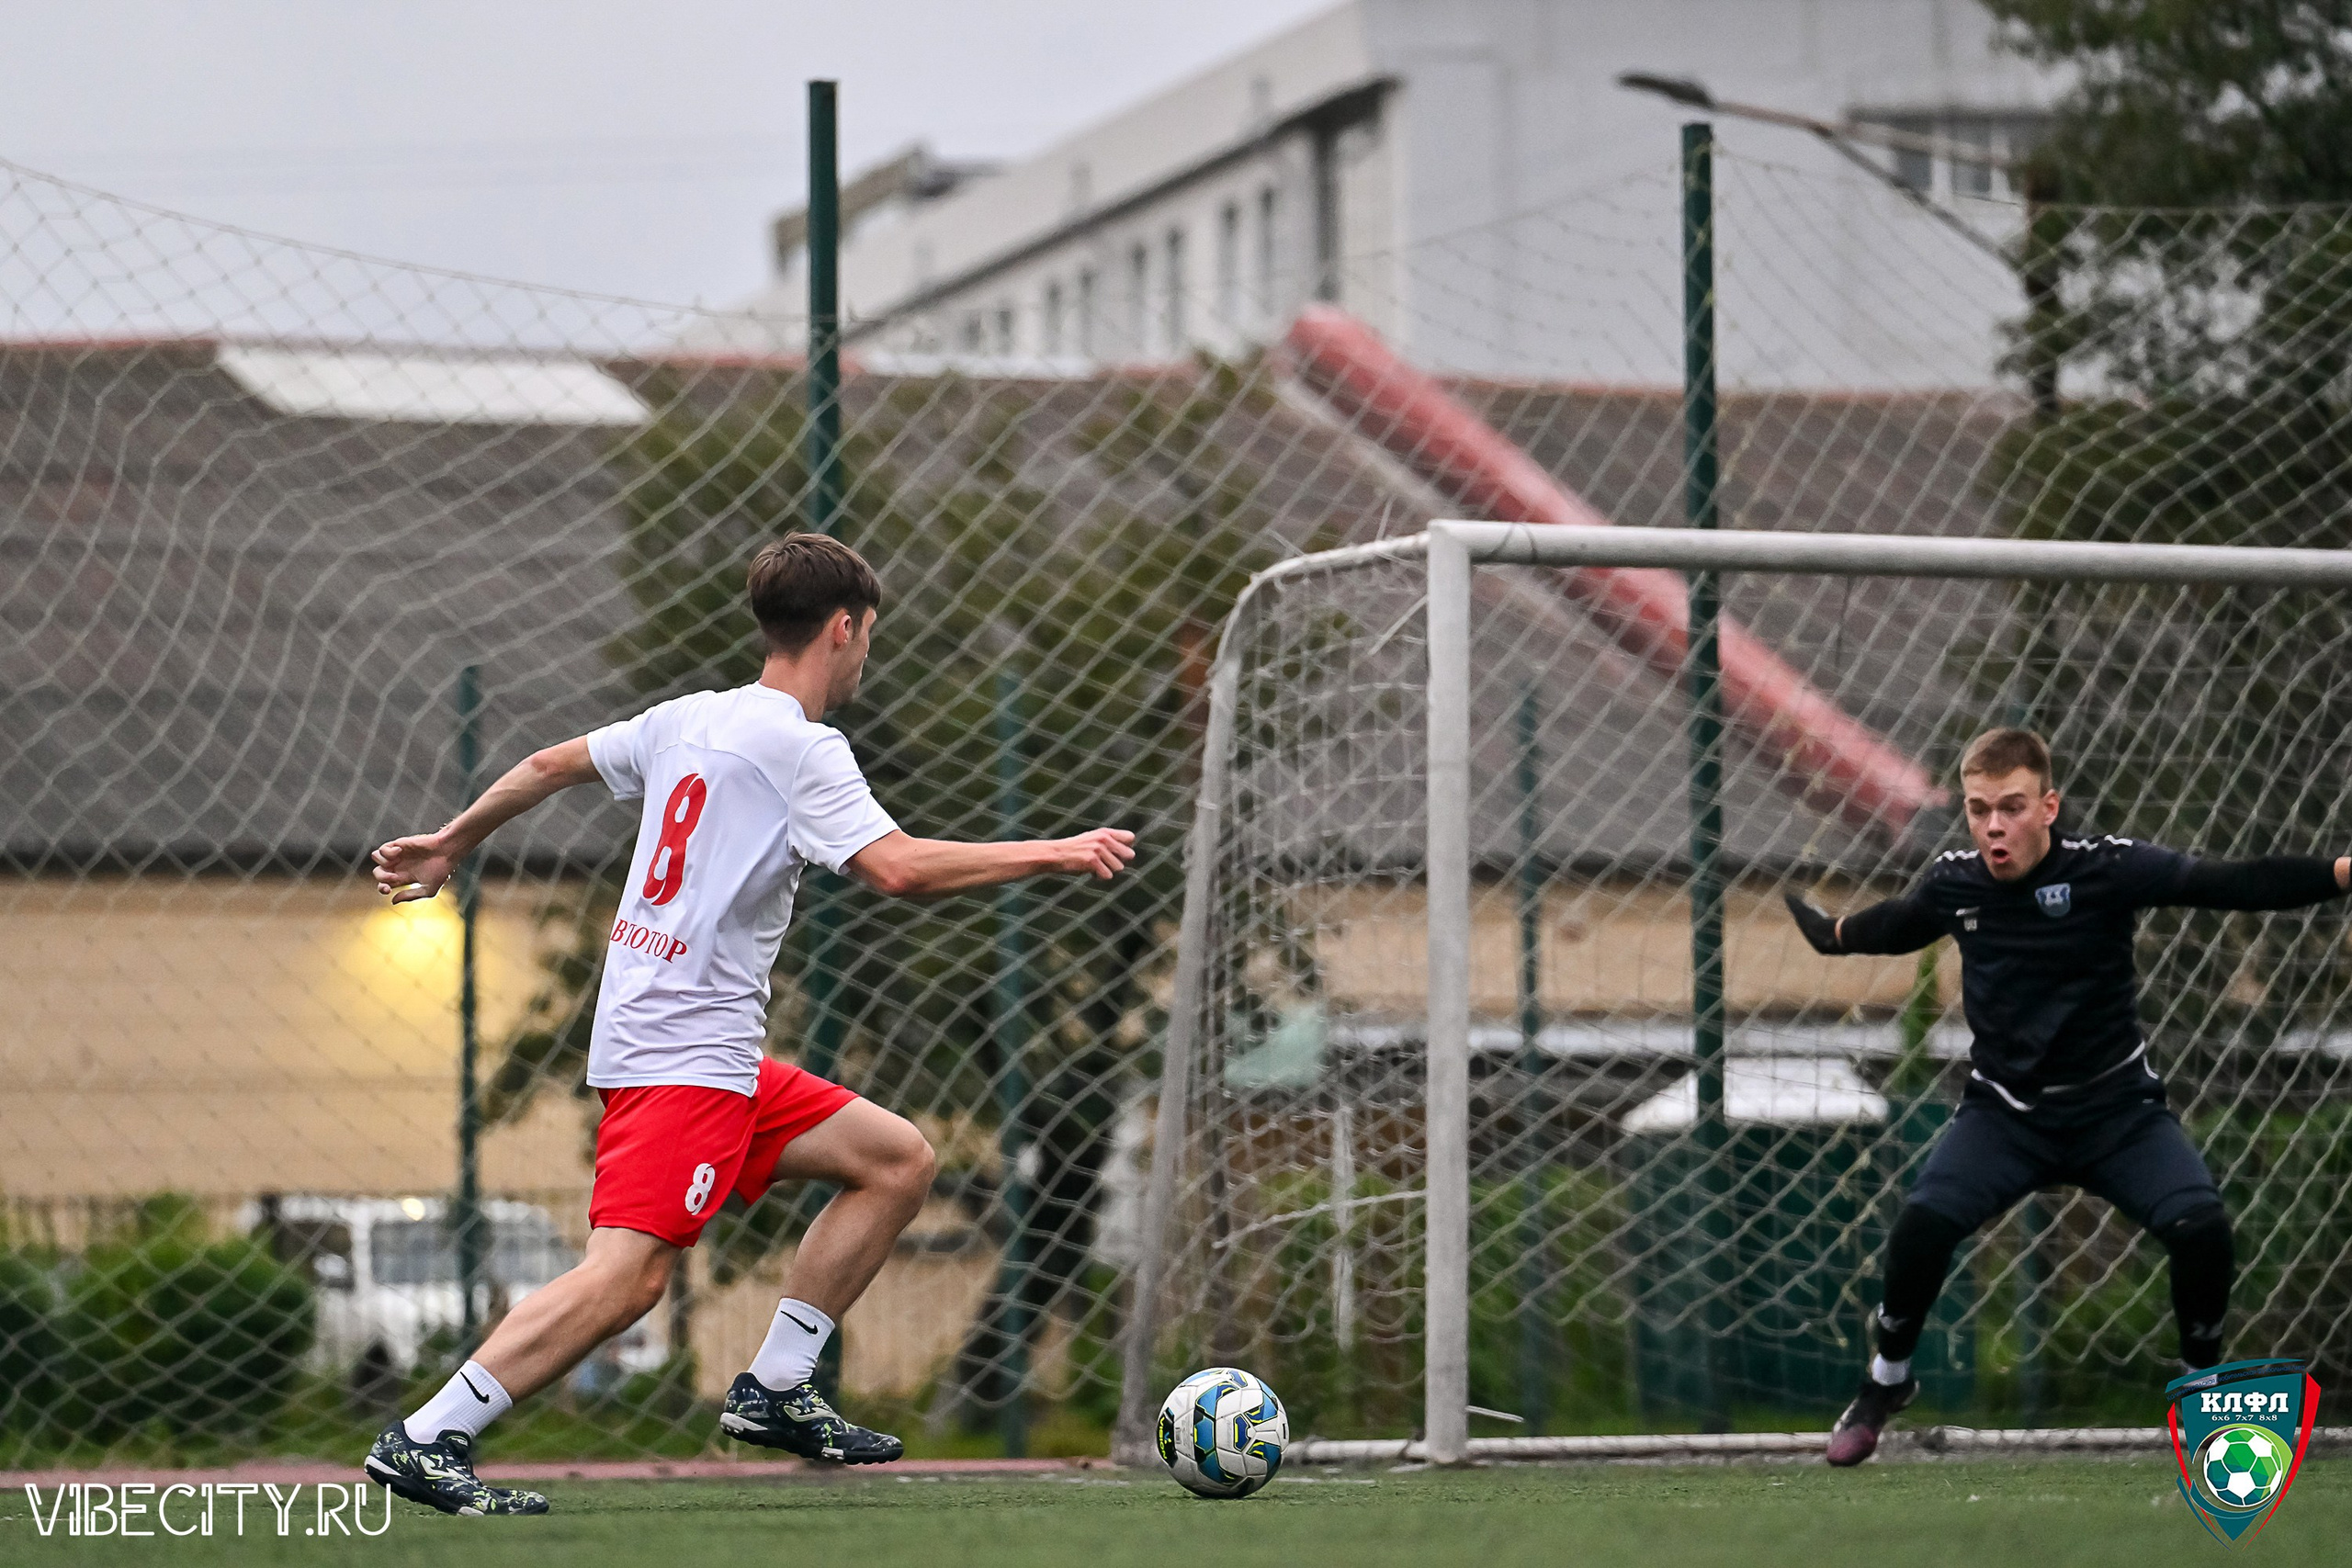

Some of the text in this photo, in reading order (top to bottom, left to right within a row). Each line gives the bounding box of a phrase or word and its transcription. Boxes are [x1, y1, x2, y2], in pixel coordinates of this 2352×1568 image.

[642, 773, 707, 906] 8
[684, 1162, 716, 1216] 8
[1159, 1416, 1168, 1460] VISION
